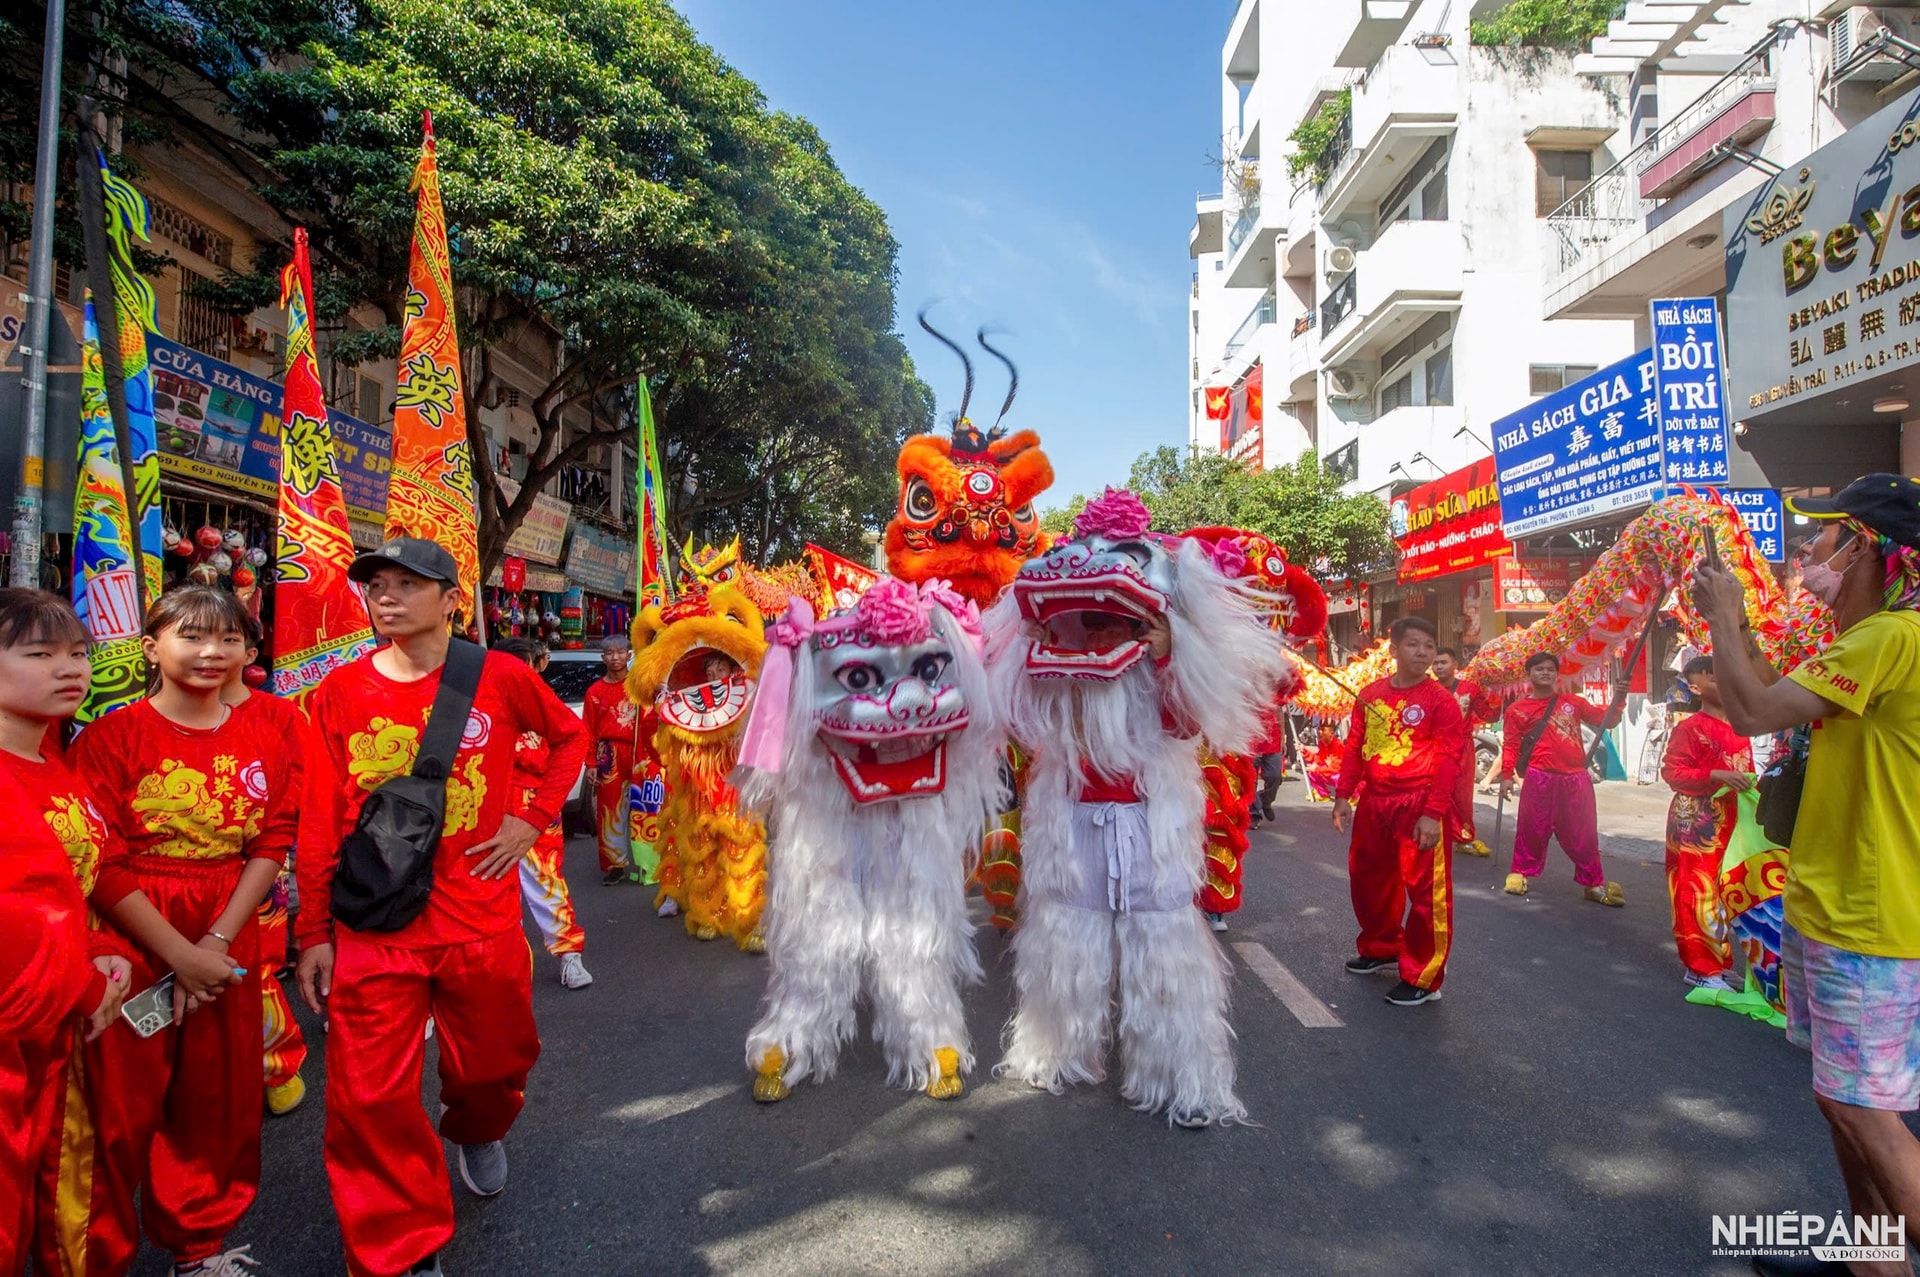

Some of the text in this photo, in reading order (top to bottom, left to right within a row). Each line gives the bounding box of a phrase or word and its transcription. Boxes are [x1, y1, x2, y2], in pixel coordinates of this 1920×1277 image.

[1657, 305, 1712, 326] NHÀ SÁCH
[1789, 290, 1849, 331] BEYAKI
[1660, 327, 1715, 371] BỒI
[153, 347, 206, 379] CỬA
[212, 370, 273, 404] HÀNG
[334, 420, 356, 439] CỤ
[1664, 374, 1718, 411] TRÍ
[1498, 423, 1529, 452] NHÀ
[1532, 404, 1576, 438] SÁCH
[1580, 375, 1632, 416] GIA
[1665, 413, 1720, 431] DỜI VỀ ĐÂY
[192, 465, 213, 476] 693
[217, 471, 258, 487] NGUYỄN
[1503, 484, 1513, 496] CÁC
[1514, 481, 1525, 493] LOẠI
[1619, 440, 1635, 456] VIẾT
[1636, 435, 1651, 451] THƯ
[1435, 491, 1462, 521] SỮA
[1722, 491, 1764, 506] SÁCH
[1740, 507, 1777, 532] HÚ
[1407, 543, 1419, 558] XỐT
[1420, 541, 1435, 555] HÀO
[1439, 532, 1466, 549] NƯỚNG
[1471, 522, 1494, 538] CHÁO
[1830, 673, 1859, 696] HOA
